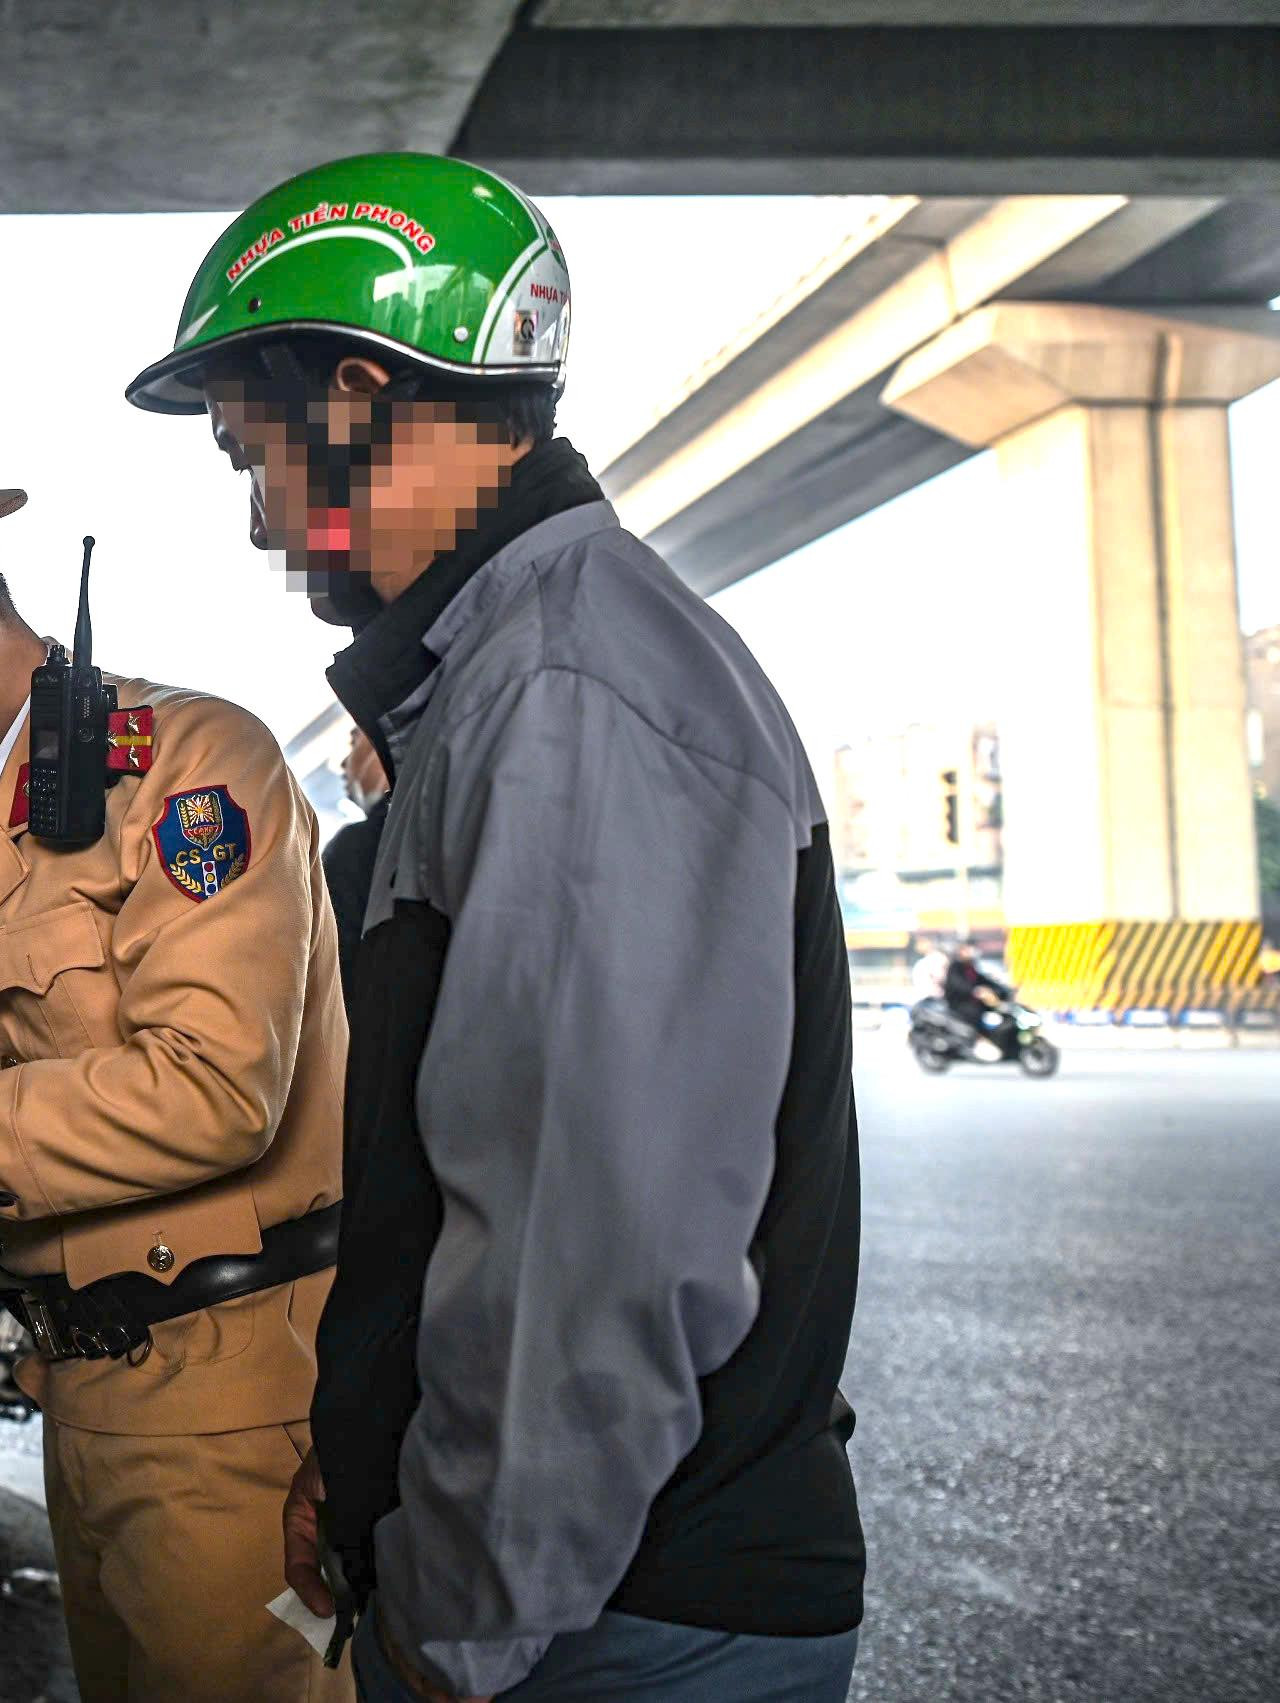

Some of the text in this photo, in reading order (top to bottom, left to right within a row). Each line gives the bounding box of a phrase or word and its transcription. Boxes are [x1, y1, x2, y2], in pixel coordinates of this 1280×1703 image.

[227, 229, 285, 282] NHỰA
[353, 203, 436, 254] PHONG
[175, 843, 236, 867] CS GT
